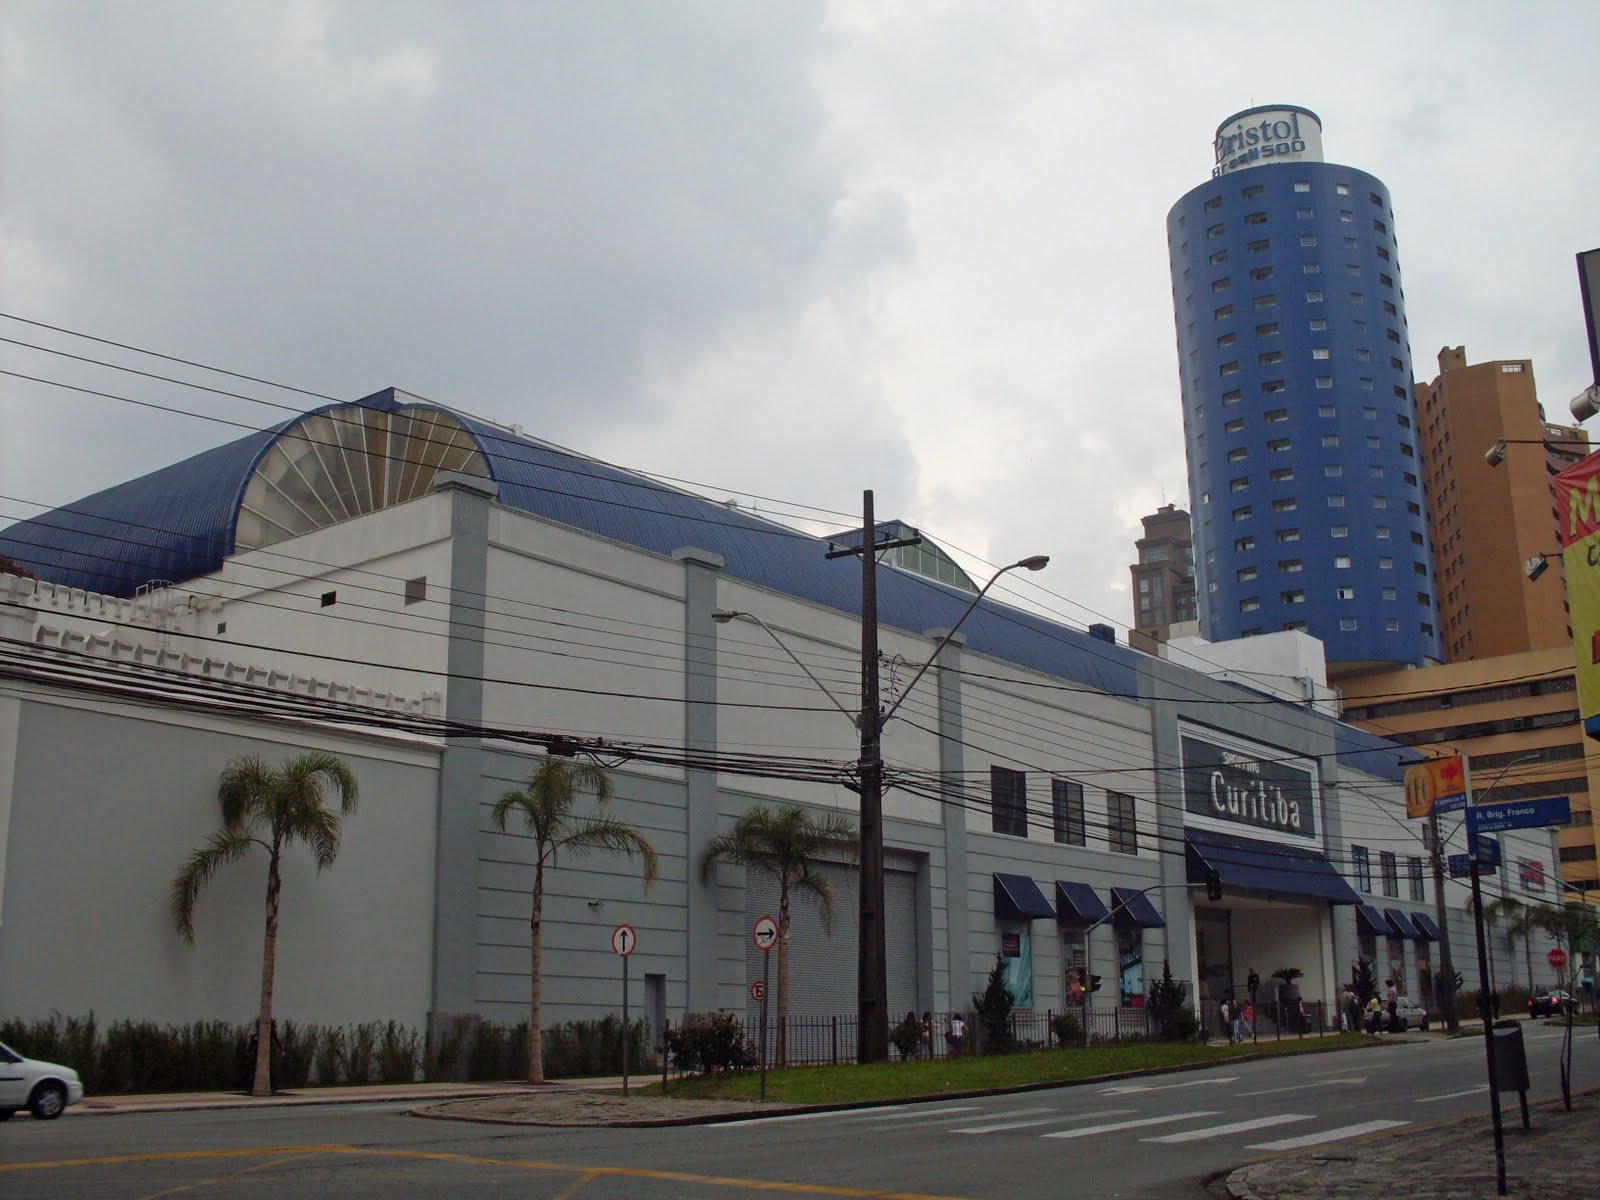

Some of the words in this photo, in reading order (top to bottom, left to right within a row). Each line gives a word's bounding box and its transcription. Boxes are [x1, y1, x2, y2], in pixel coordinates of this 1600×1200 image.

[1212, 112, 1301, 165] Bristol
[1261, 141, 1305, 157] 500
[1223, 752, 1260, 774] SHOPPING
[1210, 770, 1300, 828] Curitiba
[1476, 812, 1486, 820] R.
[1486, 811, 1506, 819] Brig.
[1507, 807, 1535, 817] Franco
